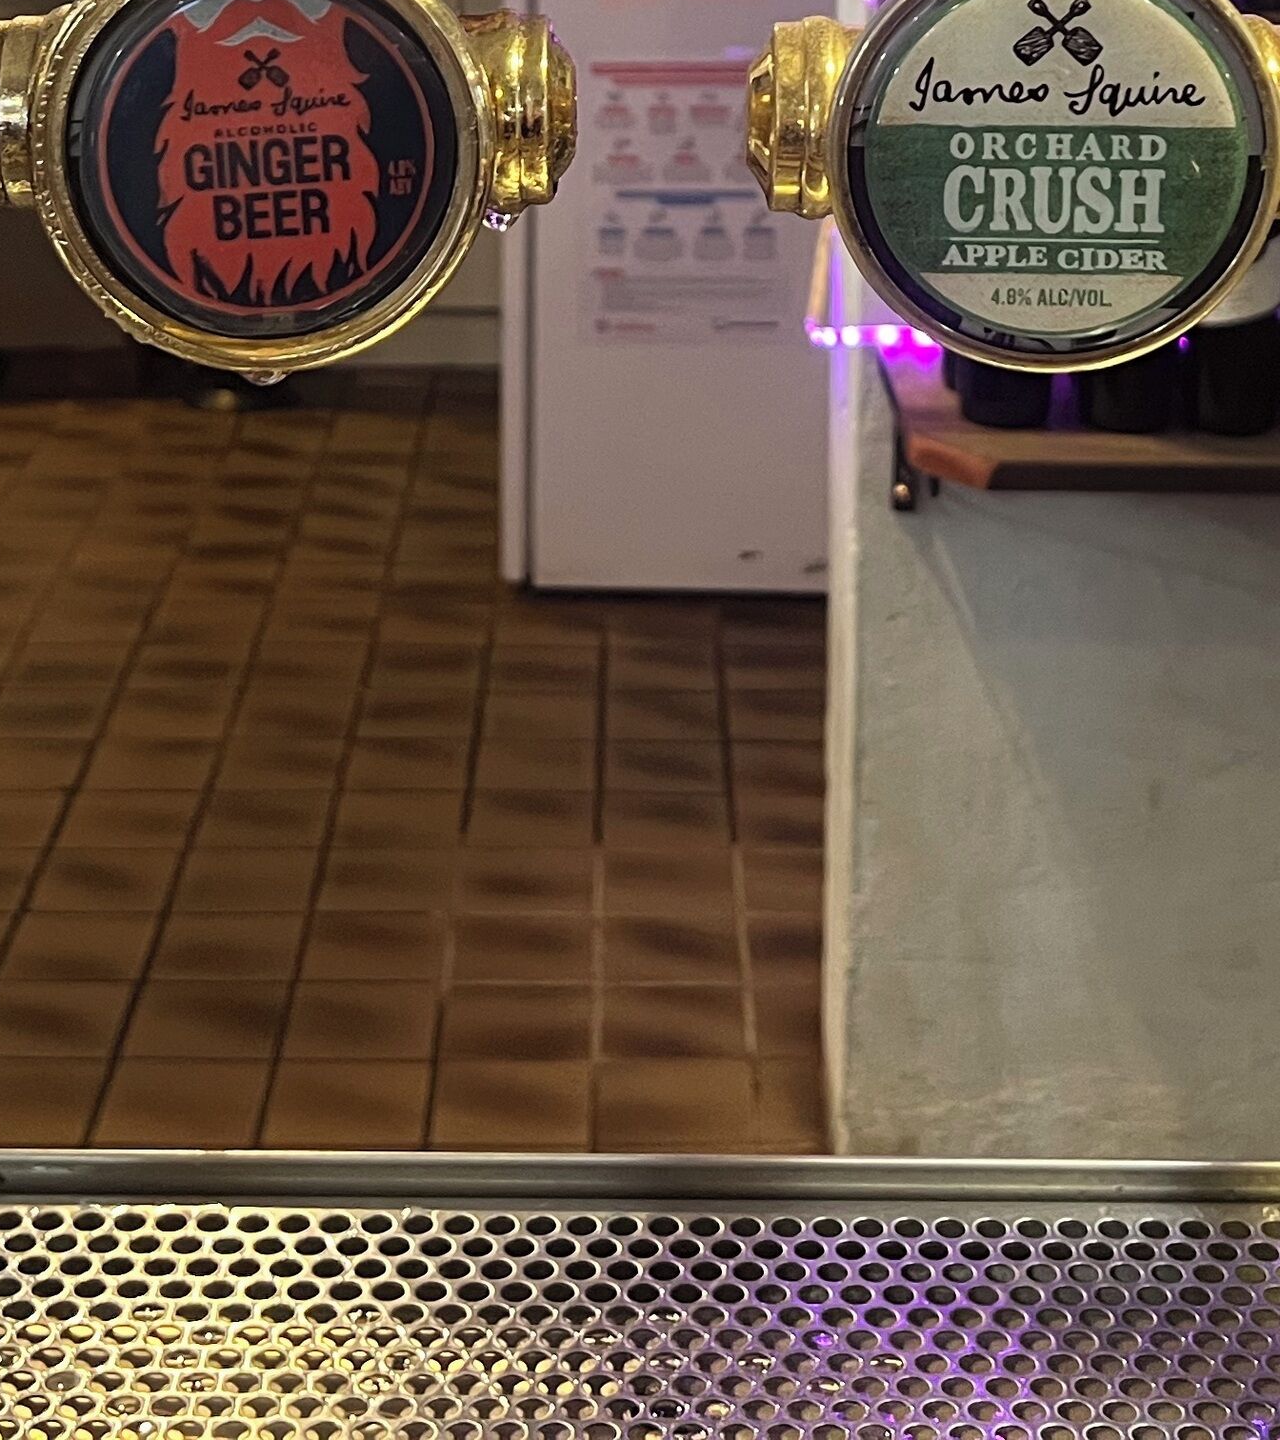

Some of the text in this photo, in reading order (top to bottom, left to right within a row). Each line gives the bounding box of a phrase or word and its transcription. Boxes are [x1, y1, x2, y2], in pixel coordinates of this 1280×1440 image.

[179, 86, 352, 122] James Squire
[908, 56, 1207, 118] James Squire
[213, 121, 319, 139] ALCOHOLIC
[948, 132, 1168, 162] ORCHARD
[183, 134, 352, 194] GINGER
[212, 187, 331, 242] BEER
[942, 163, 1166, 236] CRUSH
[941, 243, 1168, 271] APPLE CIDER
[990, 288, 1033, 308] 4.8%
